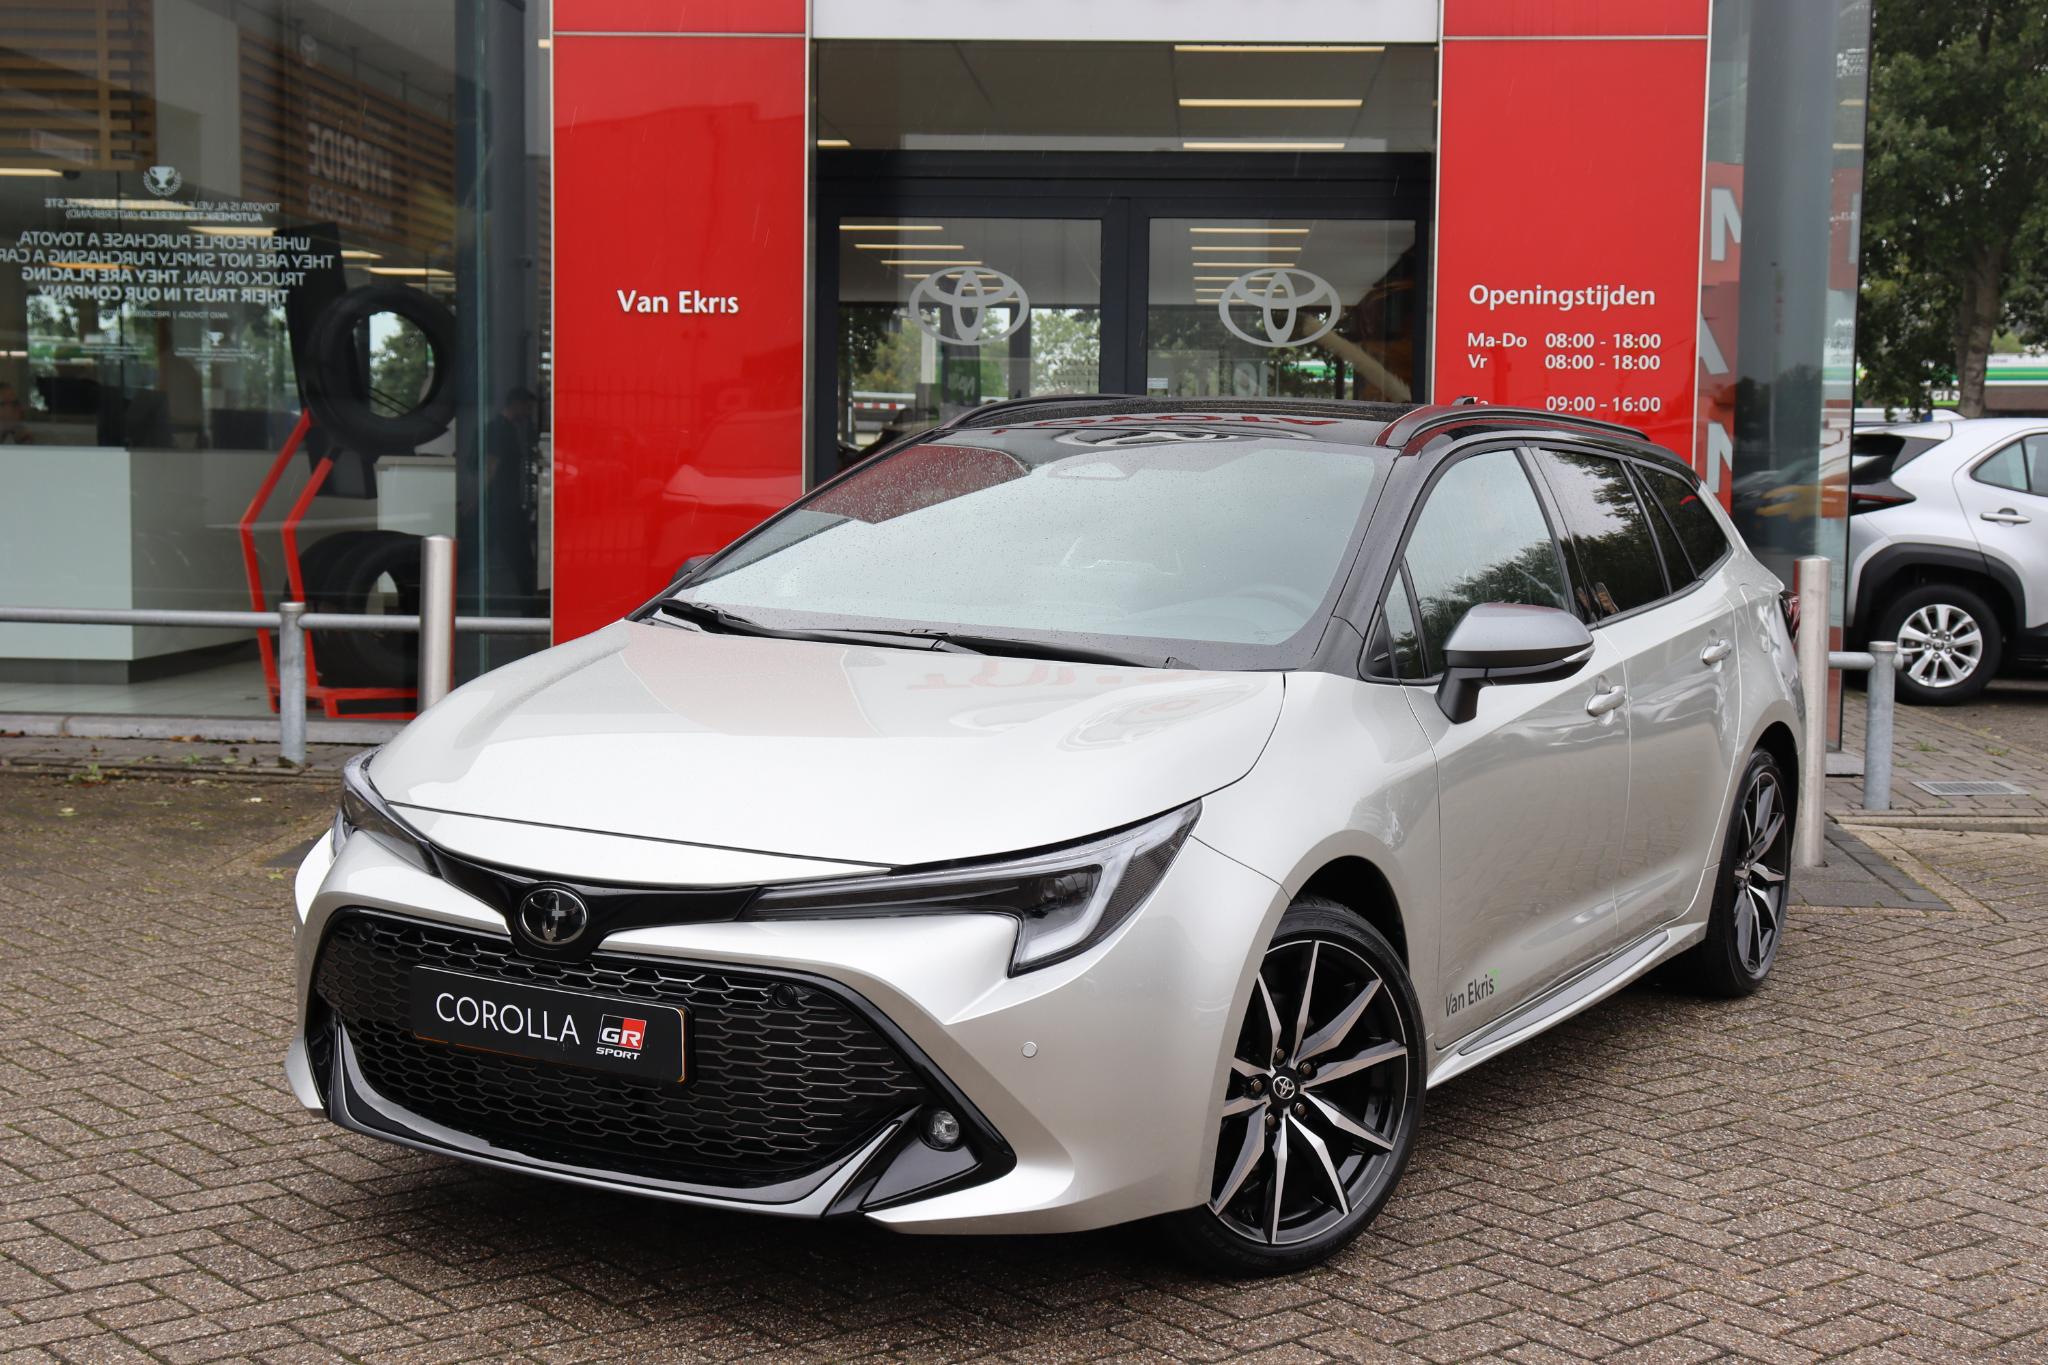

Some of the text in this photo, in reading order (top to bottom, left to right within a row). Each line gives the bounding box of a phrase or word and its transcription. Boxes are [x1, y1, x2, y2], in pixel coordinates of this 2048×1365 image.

[617, 289, 669, 313] Van
[1469, 285, 1656, 311] Openingstijden
[1467, 333, 1528, 347] Ma-Do
[1545, 333, 1595, 348] 08:00
[1613, 334, 1661, 348] 18:00
[1467, 354, 1487, 368] Vr
[1545, 354, 1594, 369] 08:00
[1612, 355, 1660, 369] 18:00
[1546, 396, 1596, 412] 09:00
[1612, 396, 1661, 412] 16:00
[1446, 974, 1495, 1017] Van Ekris
[436, 993, 580, 1045] COROLLA
[601, 1027, 641, 1047] GR
[596, 1046, 641, 1061] SPORT
